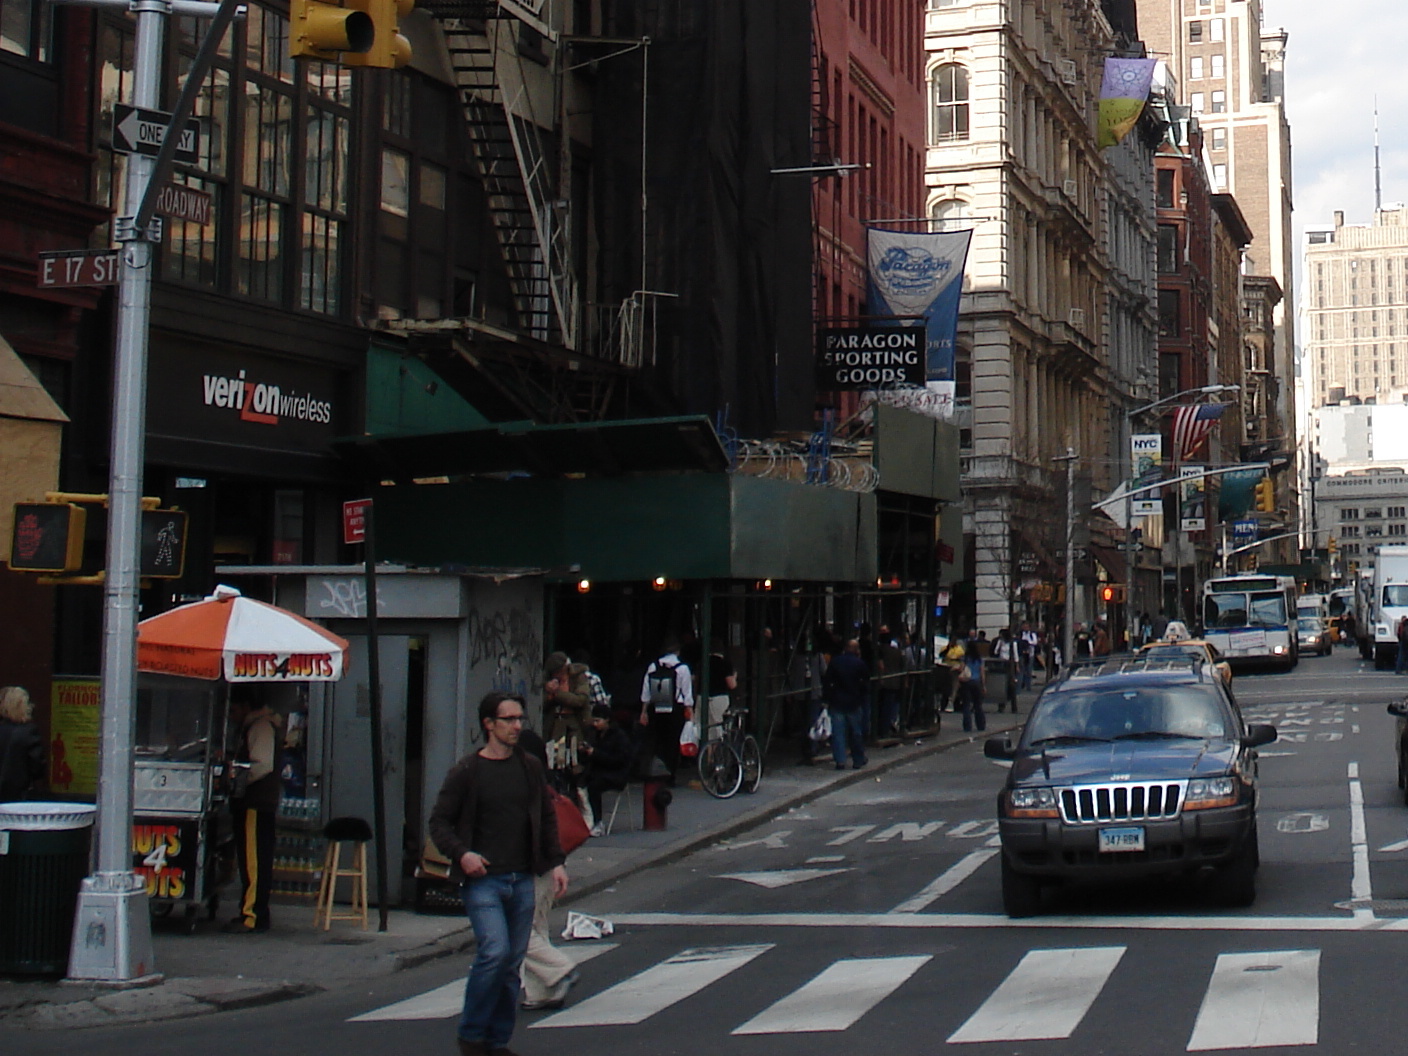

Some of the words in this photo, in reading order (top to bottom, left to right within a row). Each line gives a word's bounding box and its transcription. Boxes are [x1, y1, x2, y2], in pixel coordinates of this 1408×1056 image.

[139, 123, 163, 144] ONE
[43, 258, 56, 284] E
[65, 256, 85, 284] 17
[826, 333, 916, 349] PARAGON
[824, 350, 918, 366] SPORTING
[835, 368, 906, 383] GOODS
[203, 369, 280, 426] verizon
[279, 390, 331, 424] wireless
[1134, 439, 1158, 449] NYC
[1326, 478, 1373, 487] COMMODORE
[58, 691, 101, 705] TAILOR
[143, 844, 168, 874] 4
